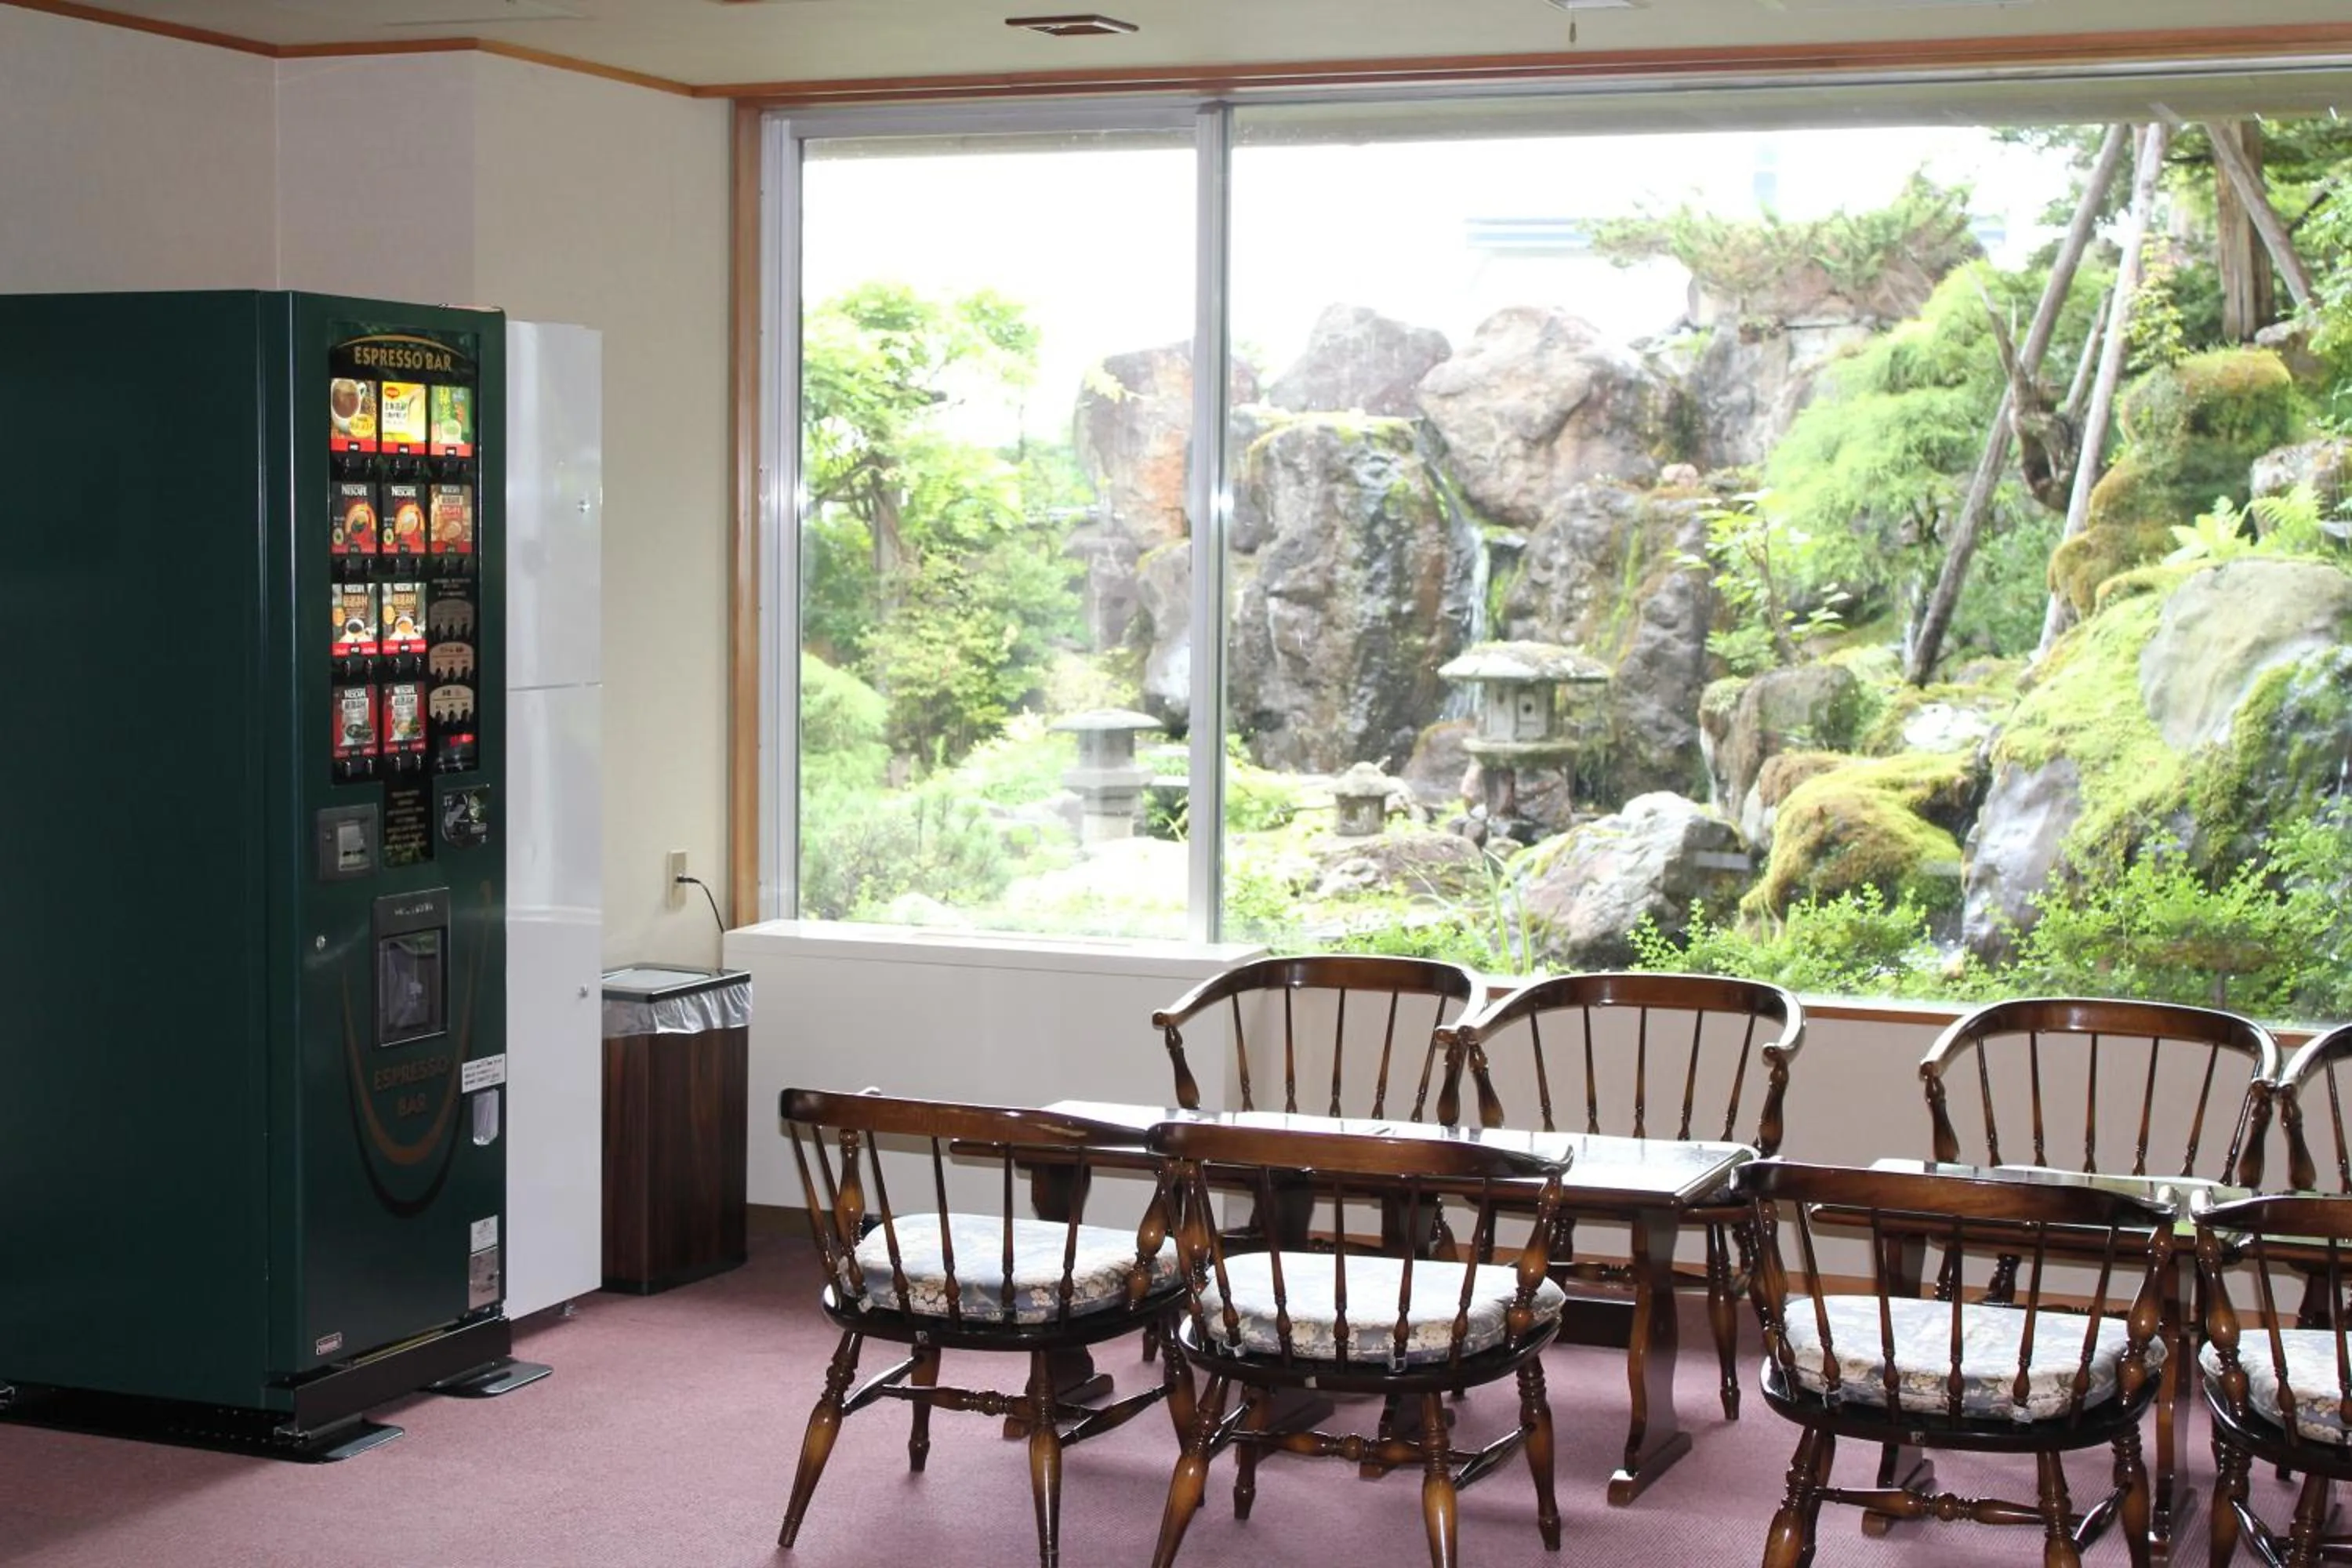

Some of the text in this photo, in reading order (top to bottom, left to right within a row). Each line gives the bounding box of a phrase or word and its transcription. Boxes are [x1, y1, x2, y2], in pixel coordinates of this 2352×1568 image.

[354, 346, 452, 372] ESPRESSO BAR
[374, 1055, 448, 1091] ESPRESSO
[397, 1092, 426, 1116] BAR
